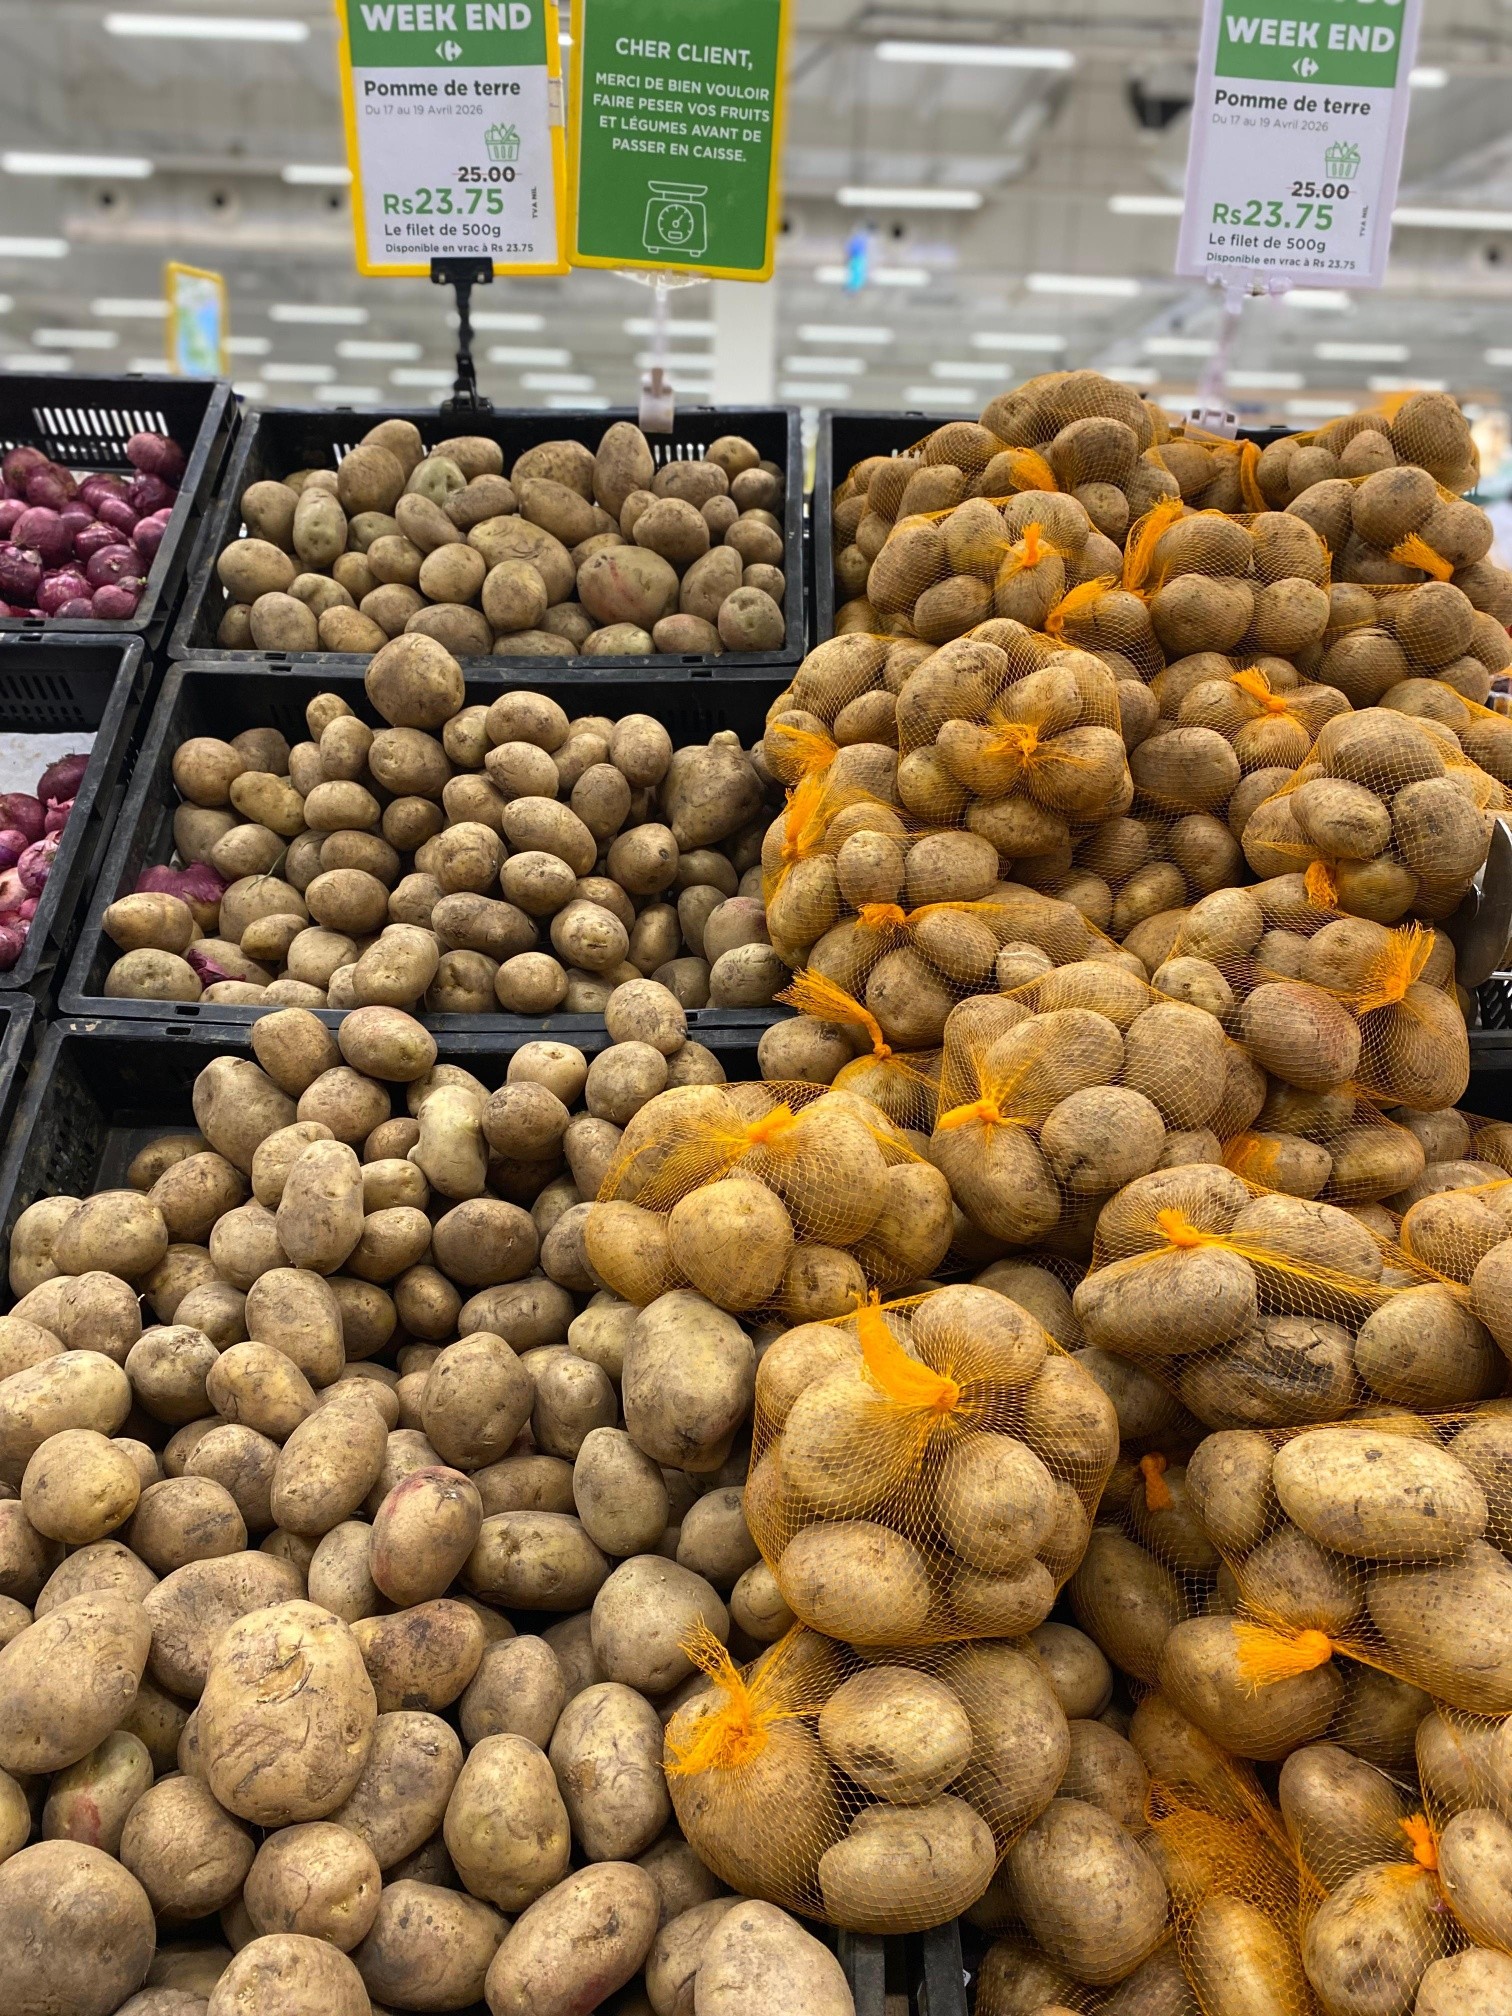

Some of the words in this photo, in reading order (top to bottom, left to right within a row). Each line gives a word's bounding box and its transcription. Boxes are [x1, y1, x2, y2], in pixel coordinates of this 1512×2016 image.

[360, 3, 458, 32] WEEK
[466, 3, 532, 31] END
[1226, 15, 1321, 49] WEEK
[1327, 23, 1395, 53] END
[615, 37, 671, 59] CHER
[677, 44, 753, 71] CLIENT,
[364, 80, 438, 96] Pomme
[445, 80, 467, 96] de
[474, 81, 520, 96] terre
[596, 72, 640, 89] MERCI
[645, 77, 664, 90] DE
[668, 79, 701, 95] BIEN
[706, 83, 769, 101] VOULOIR
[366, 105, 381, 115] Du
[383, 105, 394, 115] 17
[397, 107, 410, 115] au
[413, 105, 424, 115] 19
[428, 104, 452, 115] Avril
[456, 104, 483, 115] 2026
[593, 94, 635, 108] FAIRE
[638, 99, 683, 114] PESER
[687, 103, 716, 117] VOS
[720, 106, 770, 122] FRUITS
[1214, 89, 1287, 110] Pomme
[1293, 95, 1317, 112] de
[1323, 97, 1371, 115] terre
[600, 116, 617, 128] ET
[621, 116, 687, 135] LÉGUMES
[691, 125, 738, 140] AVANT
[742, 129, 762, 143] DE
[1212, 113, 1228, 124] Du
[1230, 115, 1241, 125] 17
[1243, 117, 1257, 127] au
[1259, 117, 1270, 128] 19
[1273, 118, 1298, 130] Avril
[1301, 120, 1329, 132] 2026
[612, 138, 665, 154] PASSER
[670, 143, 689, 157] EN
[693, 145, 747, 162] CAISSE.
[458, 166, 515, 183] 25.00
[1291, 181, 1350, 200] 25.00
[385, 224, 401, 236] Le
[407, 223, 434, 236] filet
[440, 223, 457, 236] de
[462, 223, 501, 237] 500g
[1359, 220, 1367, 237] TVA
[386, 243, 439, 253] Disponible
[482, 243, 488, 252] à
[491, 244, 503, 252] Rs
[506, 243, 534, 252] 23.75
[1209, 233, 1225, 246] Le
[1231, 234, 1258, 248] filet
[1263, 236, 1282, 249] de
[1286, 237, 1326, 253] 500g
[1206, 252, 1261, 266] Disponible
[1263, 257, 1276, 265] en
[1279, 258, 1301, 266] vrac
[1303, 258, 1310, 267] à
[1313, 259, 1325, 268] Rs
[1328, 260, 1355, 269] 23.75
